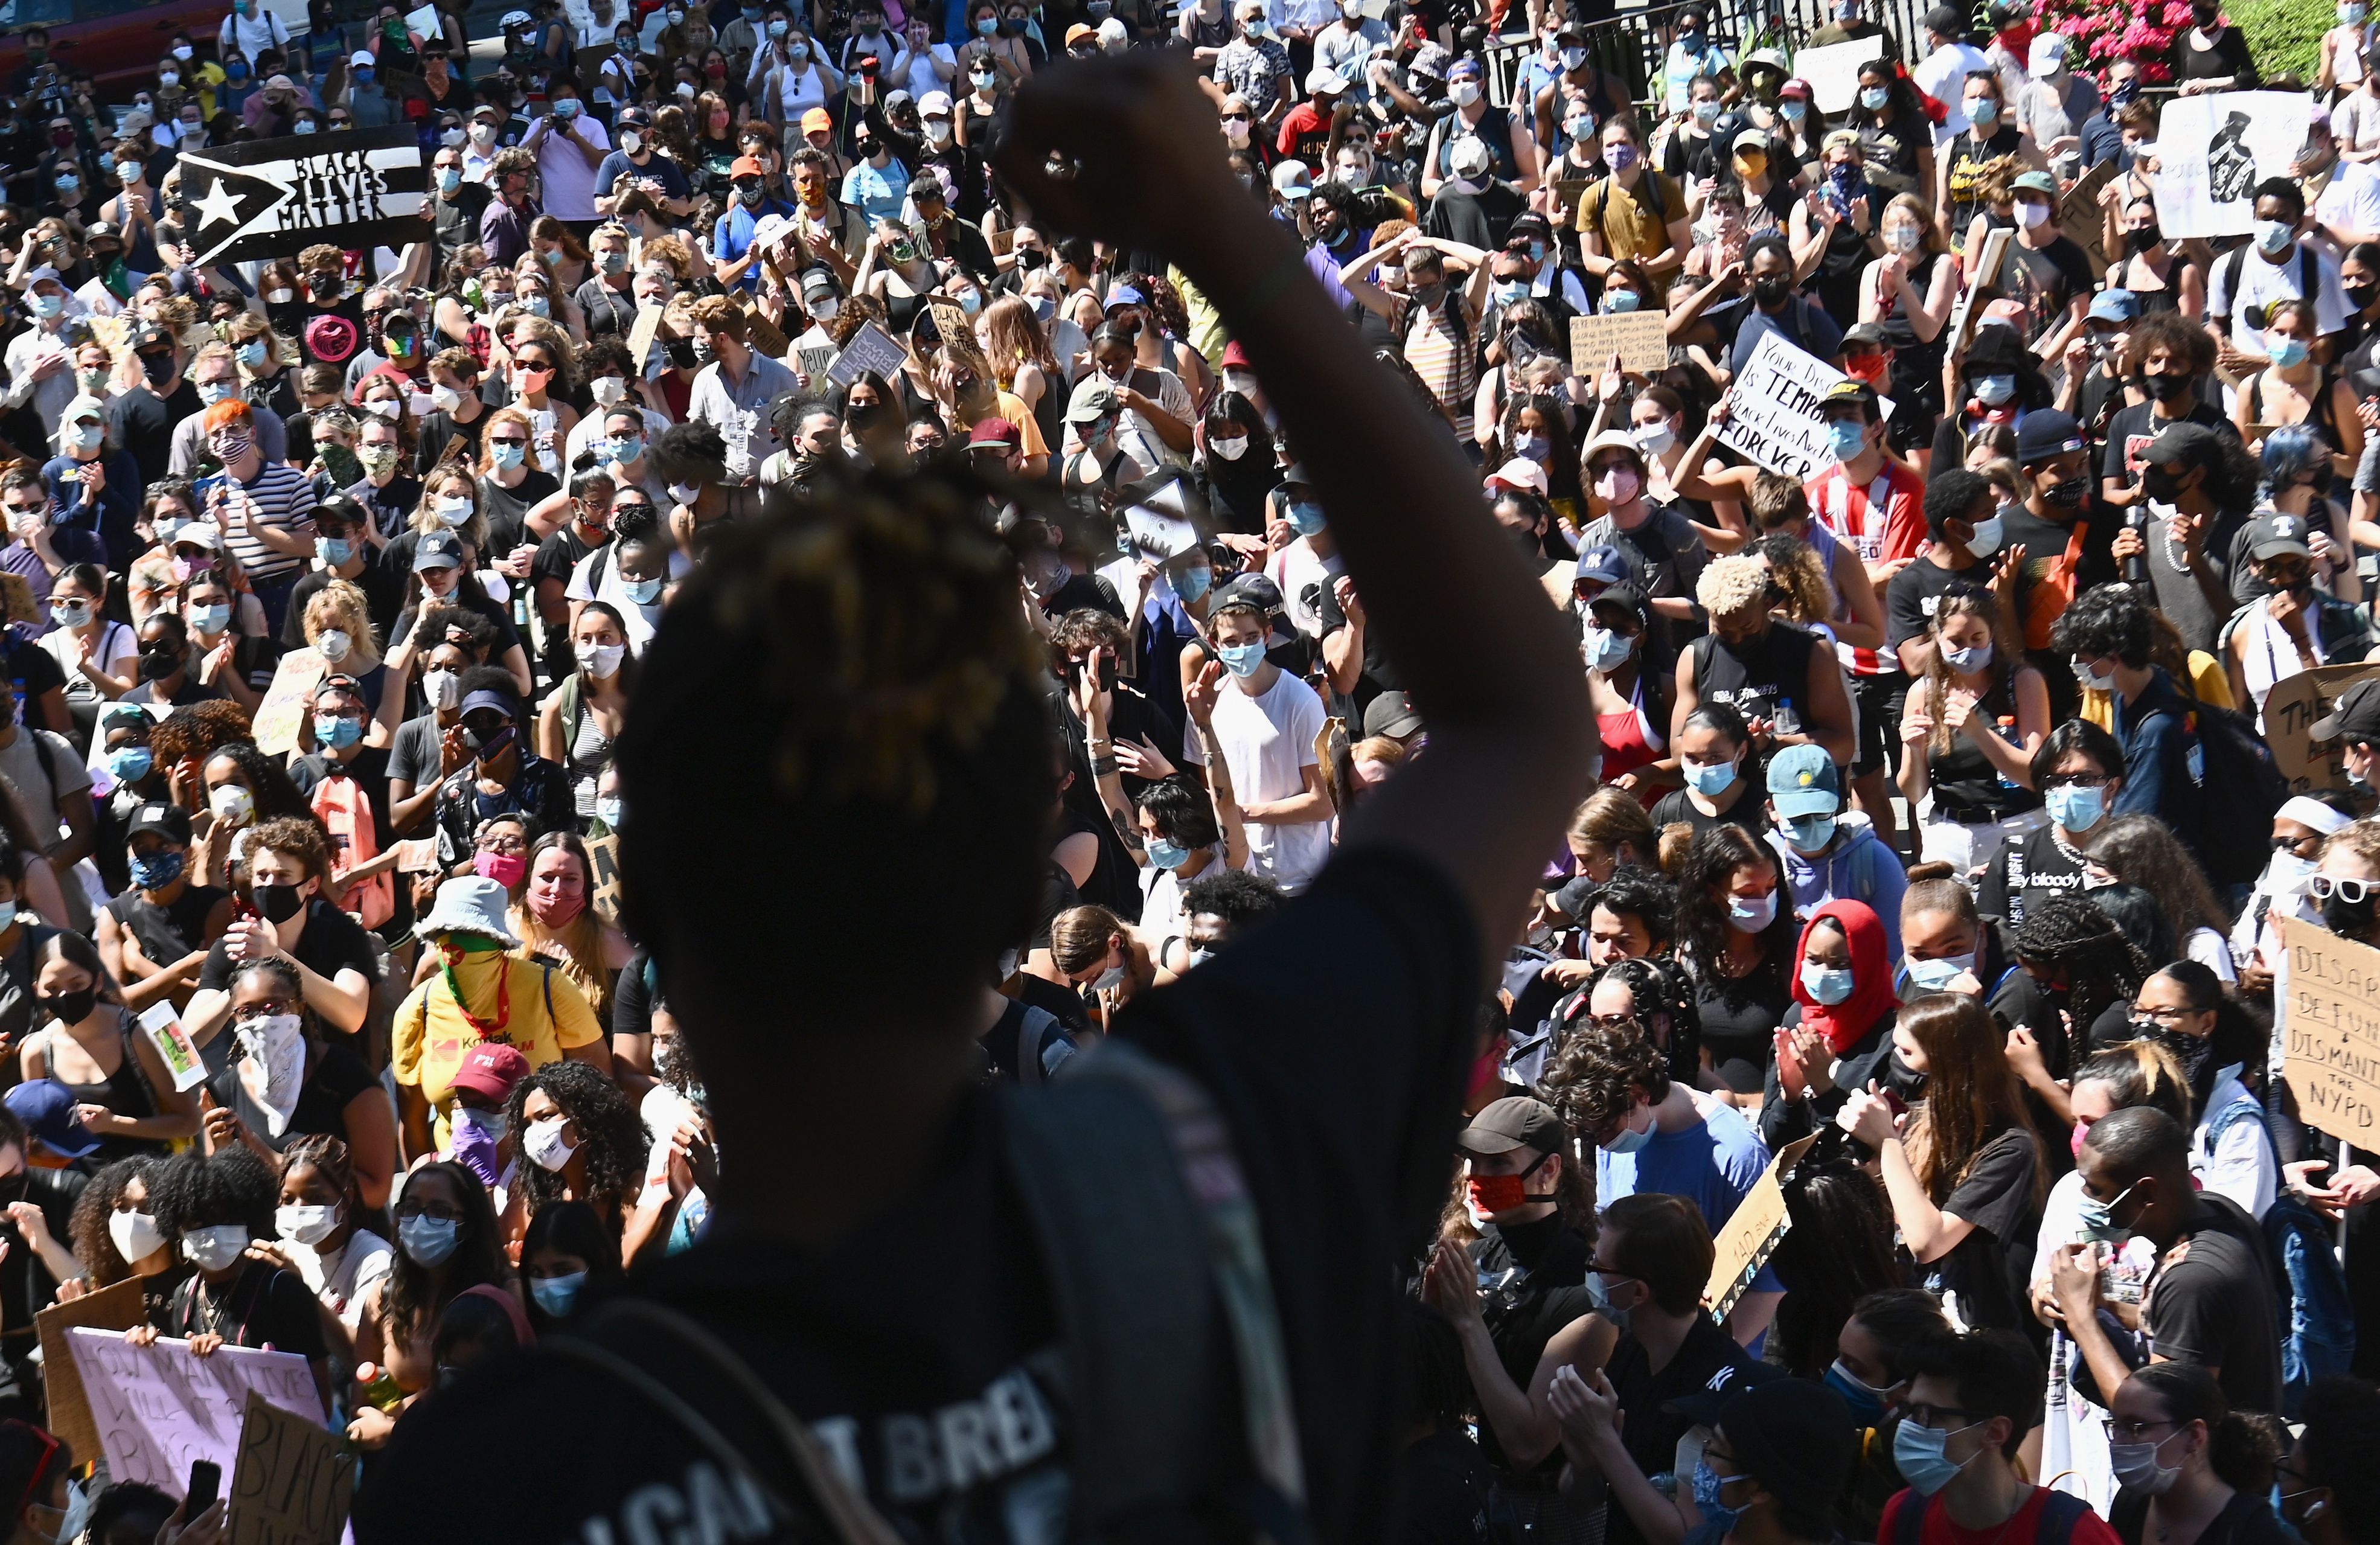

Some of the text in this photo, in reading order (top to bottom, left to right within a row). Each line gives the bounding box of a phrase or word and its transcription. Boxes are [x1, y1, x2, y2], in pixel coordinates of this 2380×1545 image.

[295, 149, 376, 180] BLACK
[304, 168, 388, 203] LIVES
[278, 194, 389, 231] MATTER
[932, 304, 965, 327] BLACK
[939, 322, 974, 341] LIVES
[840, 335, 875, 374] BLACK
[1765, 368, 1828, 426] TEMPO
[1716, 414, 1811, 482] FOREVER
[1147, 512, 1177, 539] FOR
[2031, 871, 2081, 889] bloody
[2295, 945, 2380, 1003] DISAR
[2298, 991, 2380, 1042] DEFUN
[2291, 1029, 2380, 1083] DISMANT
[2327, 1073, 2356, 1092] THE
[2310, 1081, 2374, 1128] NYPD
[75, 1340, 140, 1378] HOW
[106, 1427, 213, 1486] BLAC
[237, 1406, 354, 1540] BLACK
